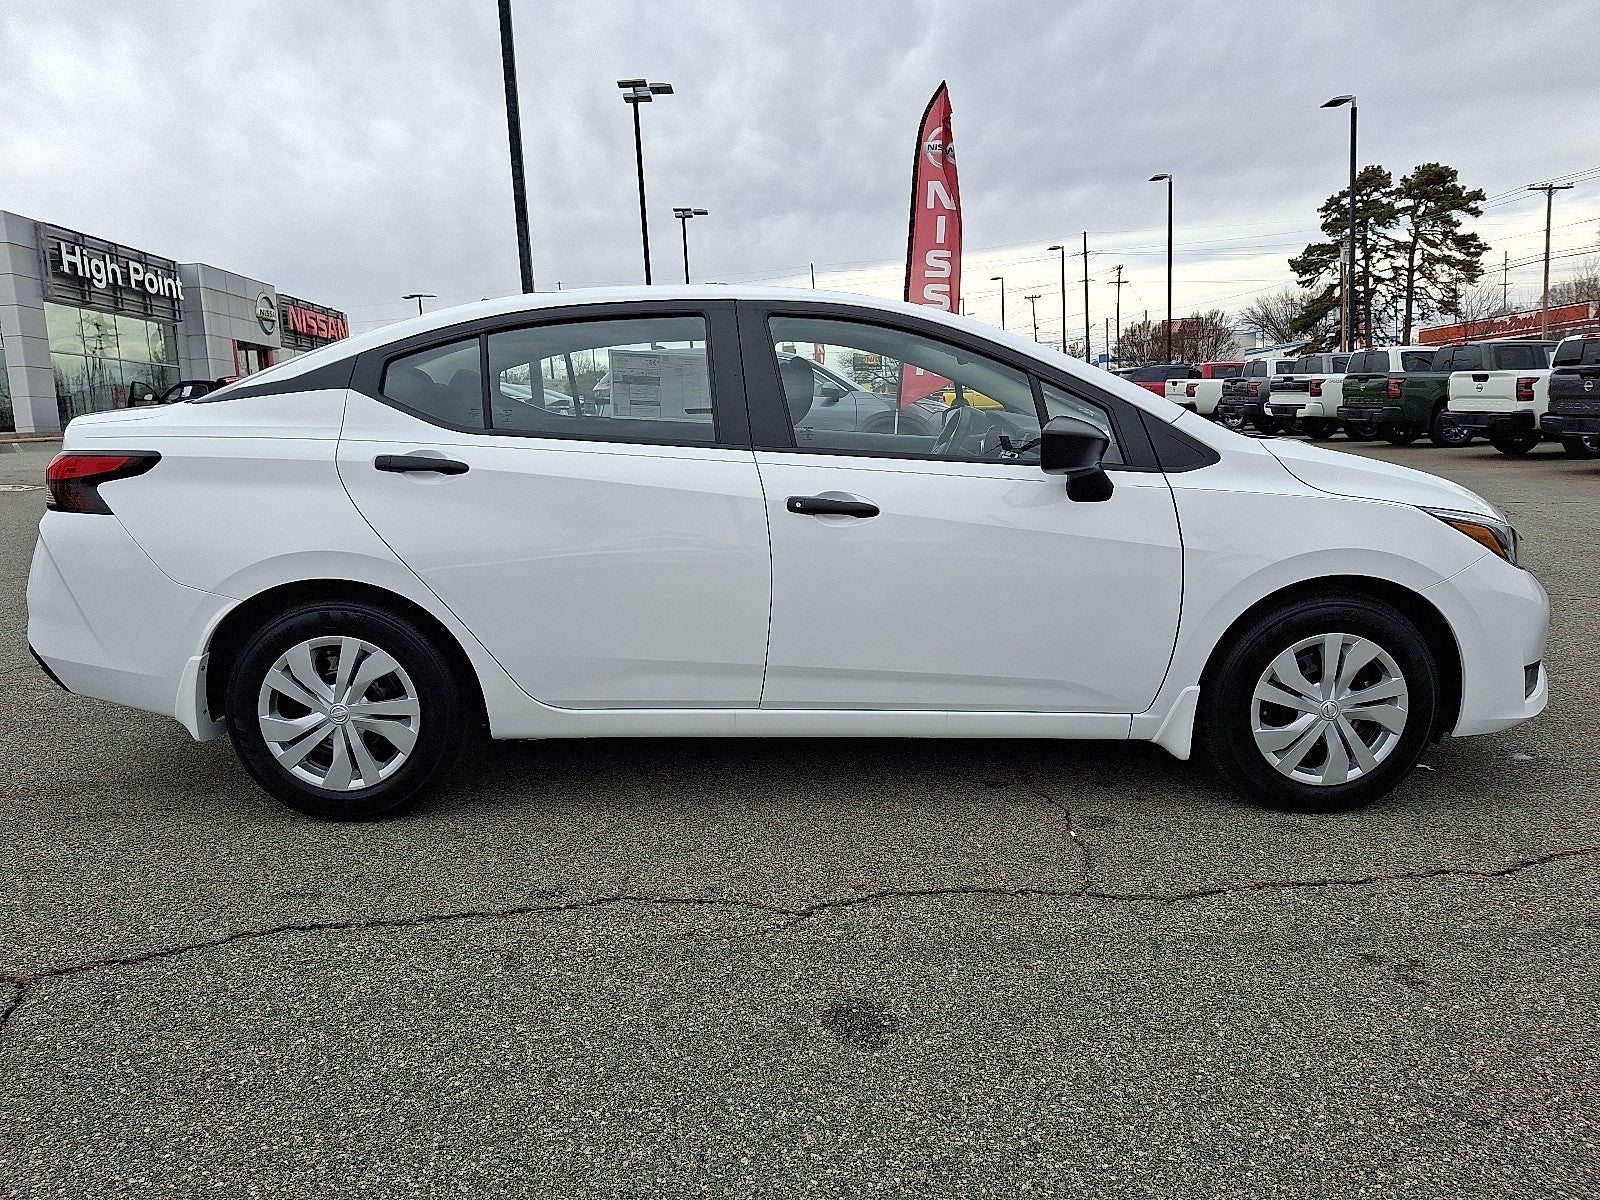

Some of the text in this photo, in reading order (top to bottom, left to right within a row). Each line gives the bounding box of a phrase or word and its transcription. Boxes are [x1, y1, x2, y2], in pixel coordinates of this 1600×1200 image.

[60, 242, 184, 300] High Point
[287, 305, 349, 341] NISSAN
